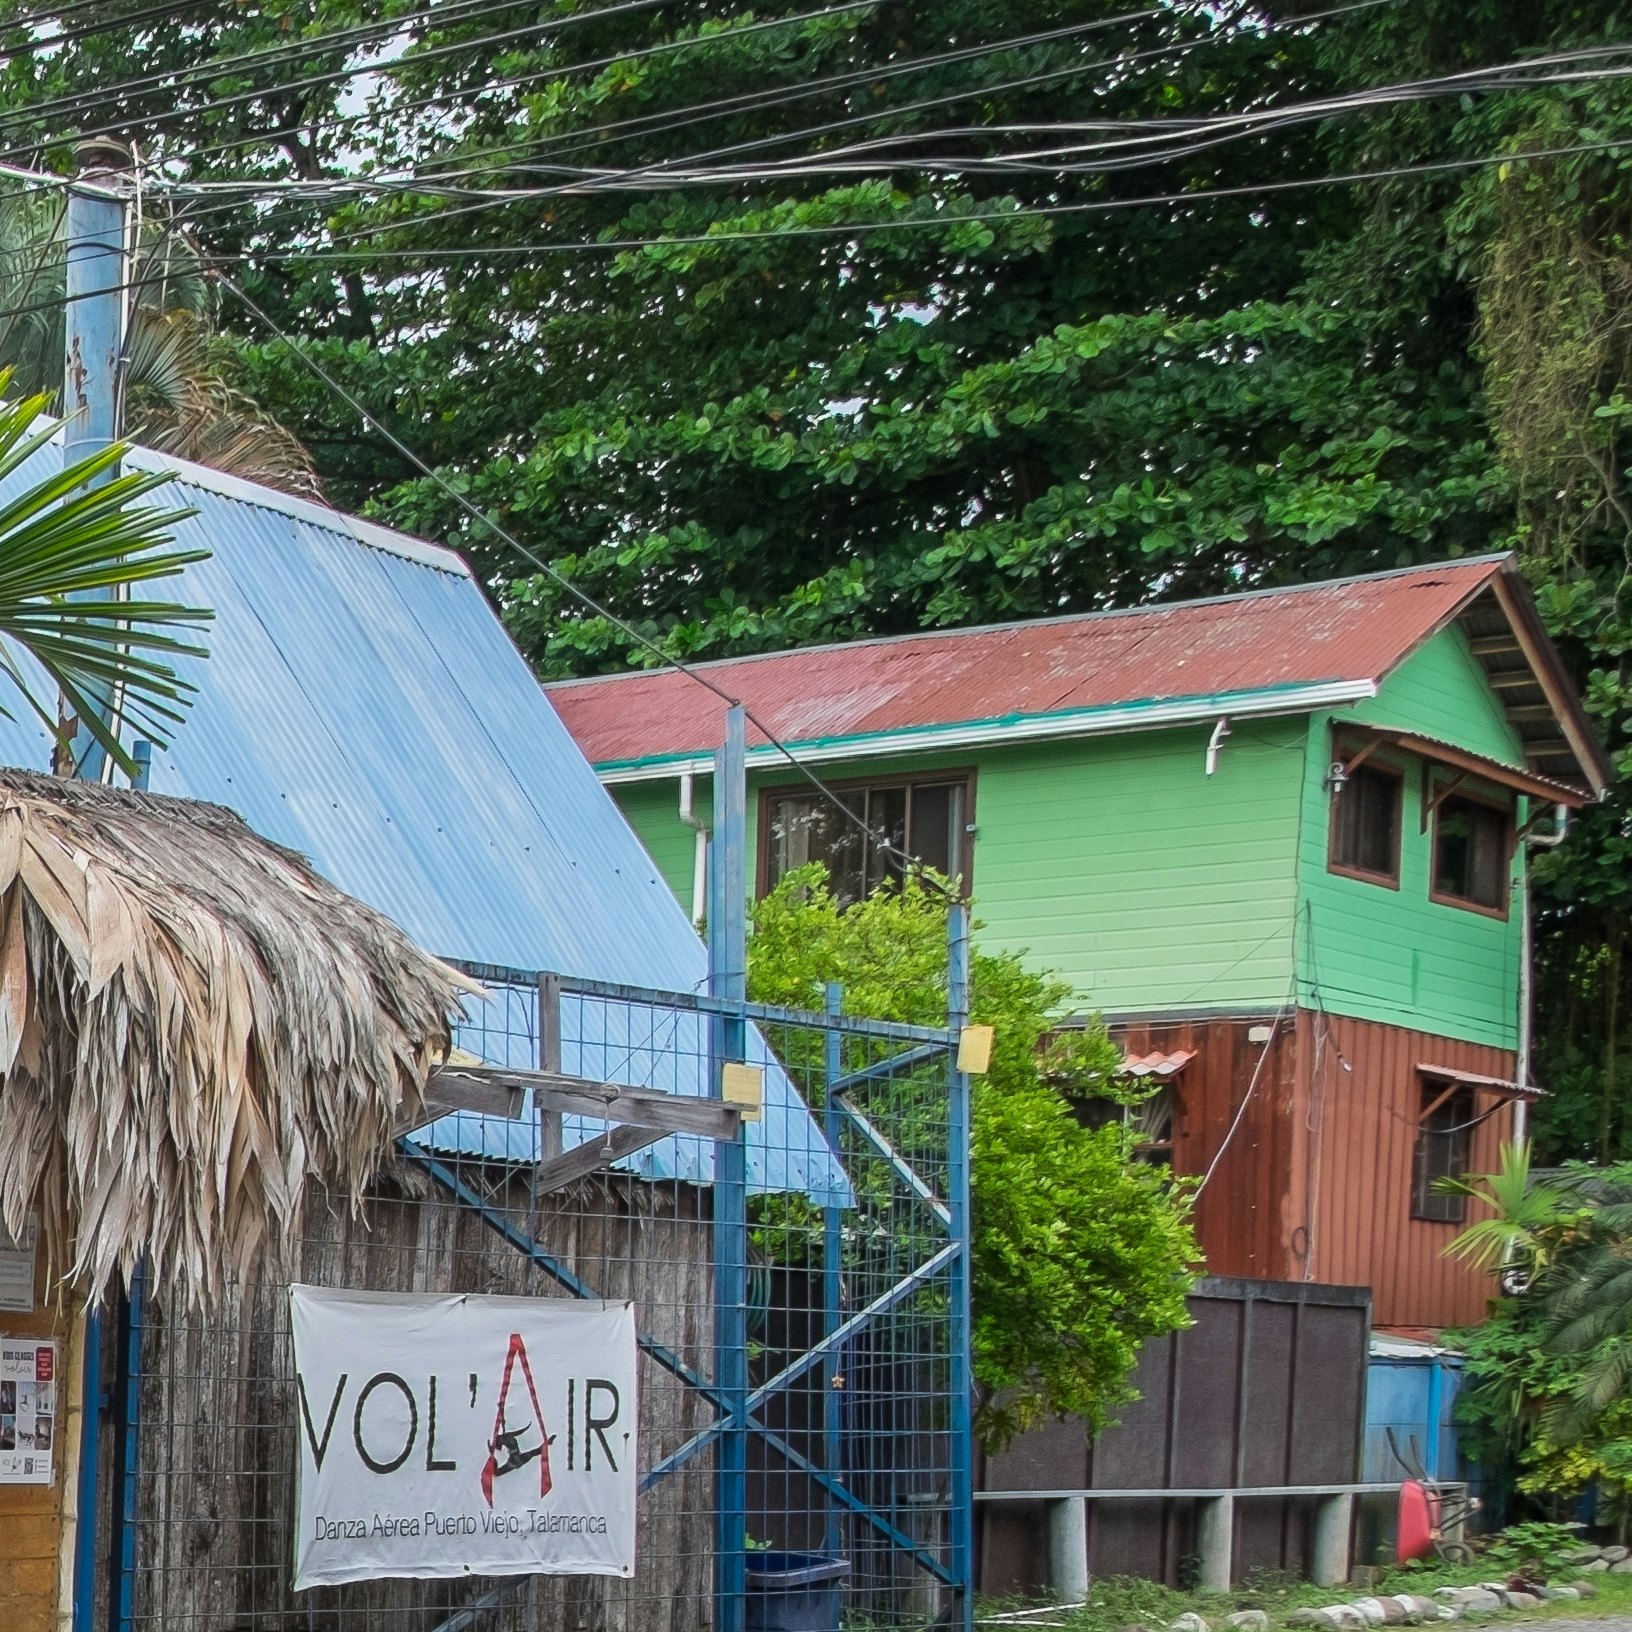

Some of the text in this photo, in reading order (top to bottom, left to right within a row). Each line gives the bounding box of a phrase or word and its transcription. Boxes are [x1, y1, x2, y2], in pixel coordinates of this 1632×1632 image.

[315, 1515, 367, 1541] Danza
[370, 1512, 421, 1538] Aérea
[424, 1510, 477, 1536] Puerto
[526, 1508, 608, 1536] Talamanca
